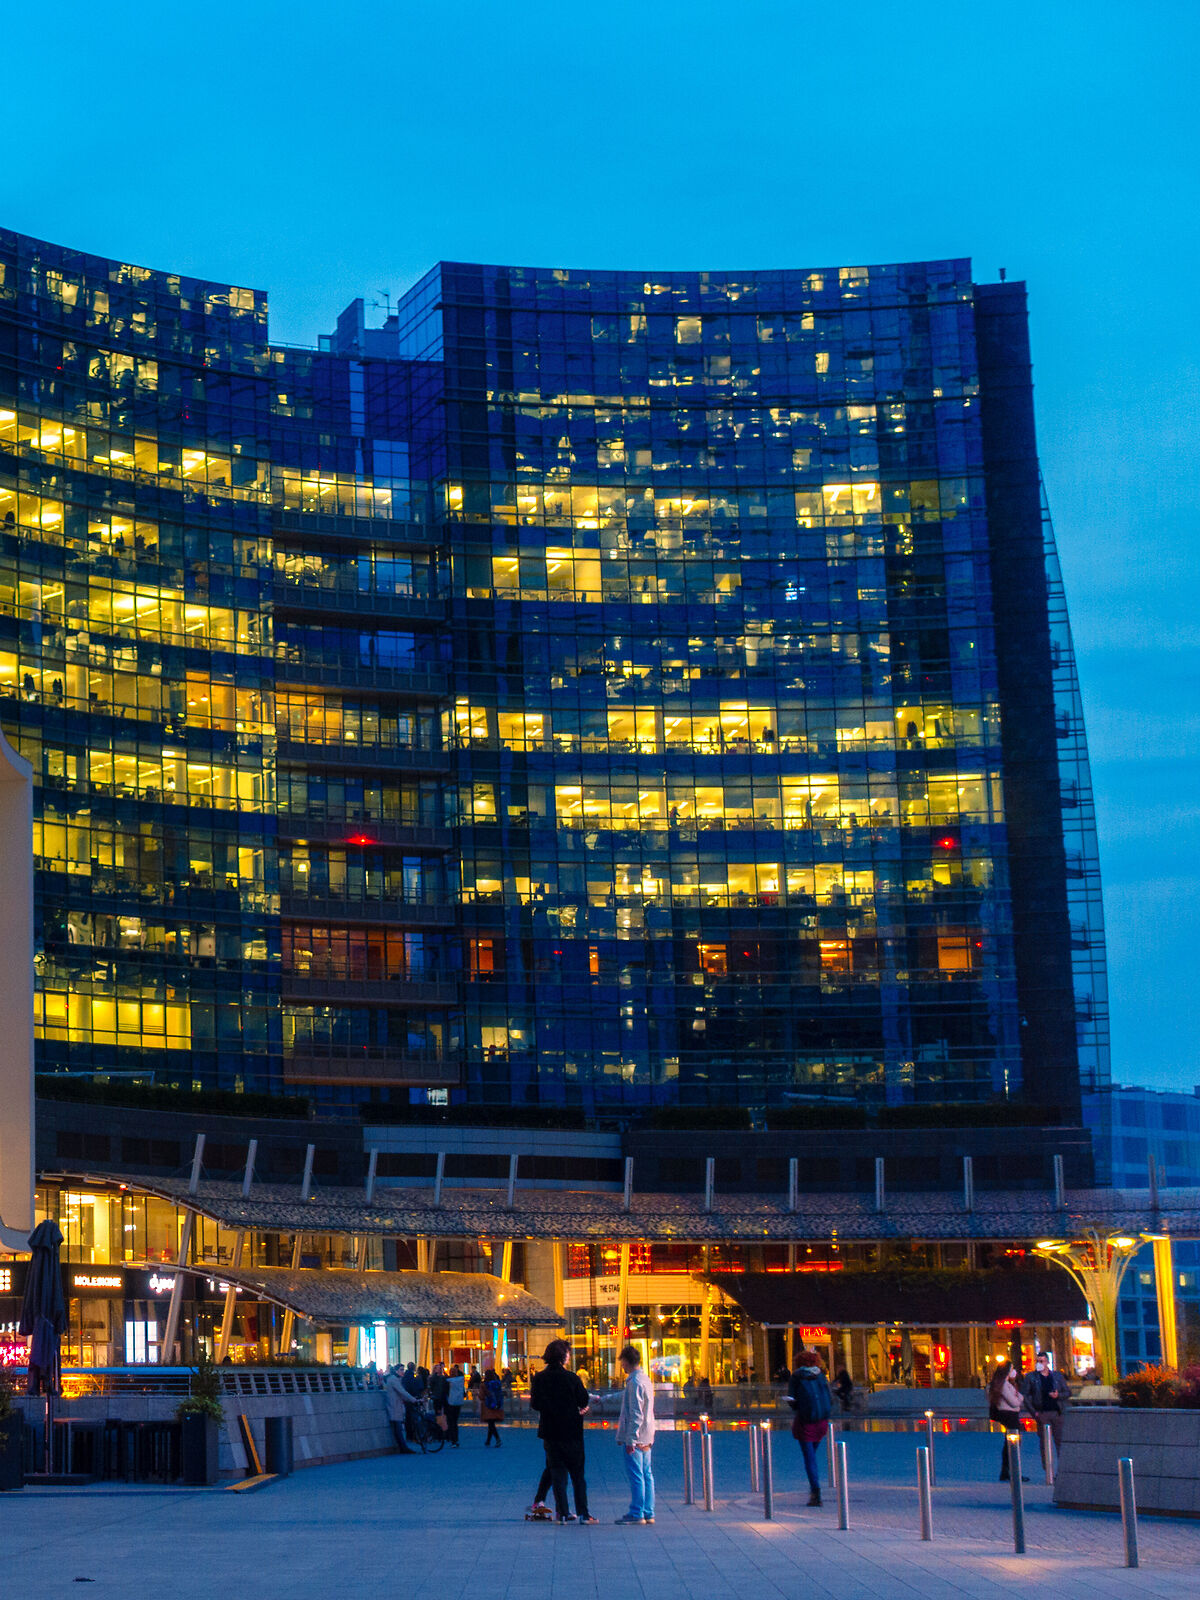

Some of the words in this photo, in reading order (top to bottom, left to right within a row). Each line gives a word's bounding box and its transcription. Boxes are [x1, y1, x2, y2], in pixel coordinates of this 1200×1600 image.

[74, 1275, 122, 1287] MOLESKINE
[609, 1283, 620, 1292] STAG
[803, 1328, 824, 1336] PLAY
